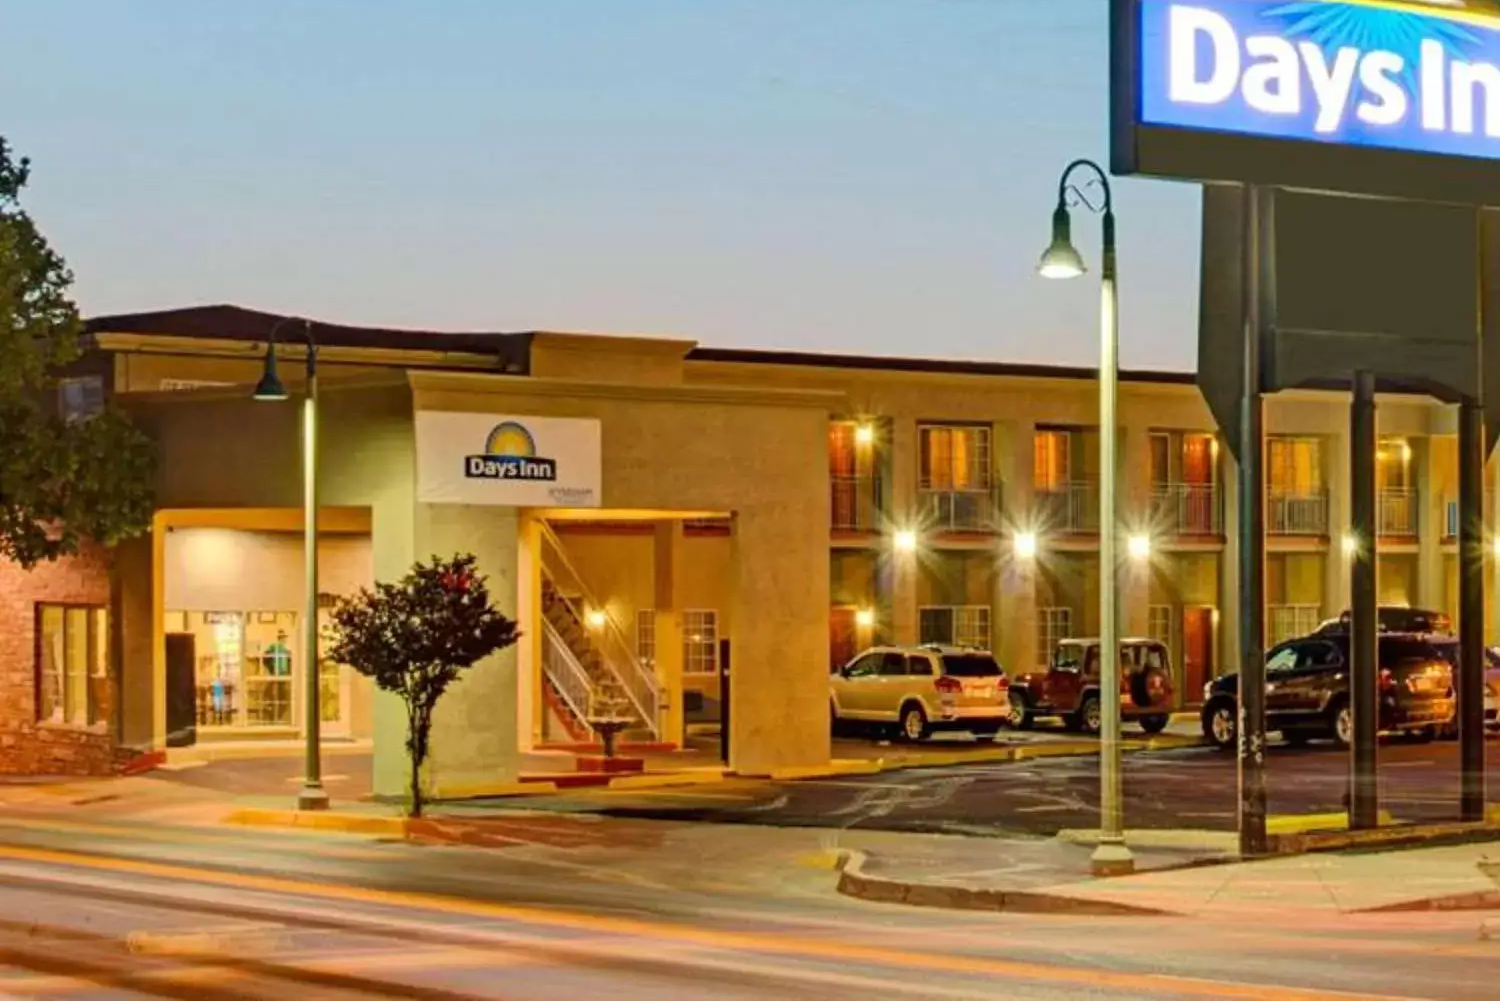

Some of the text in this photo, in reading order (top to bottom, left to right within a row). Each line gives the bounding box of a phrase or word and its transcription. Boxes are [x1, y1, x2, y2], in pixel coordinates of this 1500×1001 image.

[1168, 4, 1407, 133] Days
[470, 458, 552, 478] Days Inn
